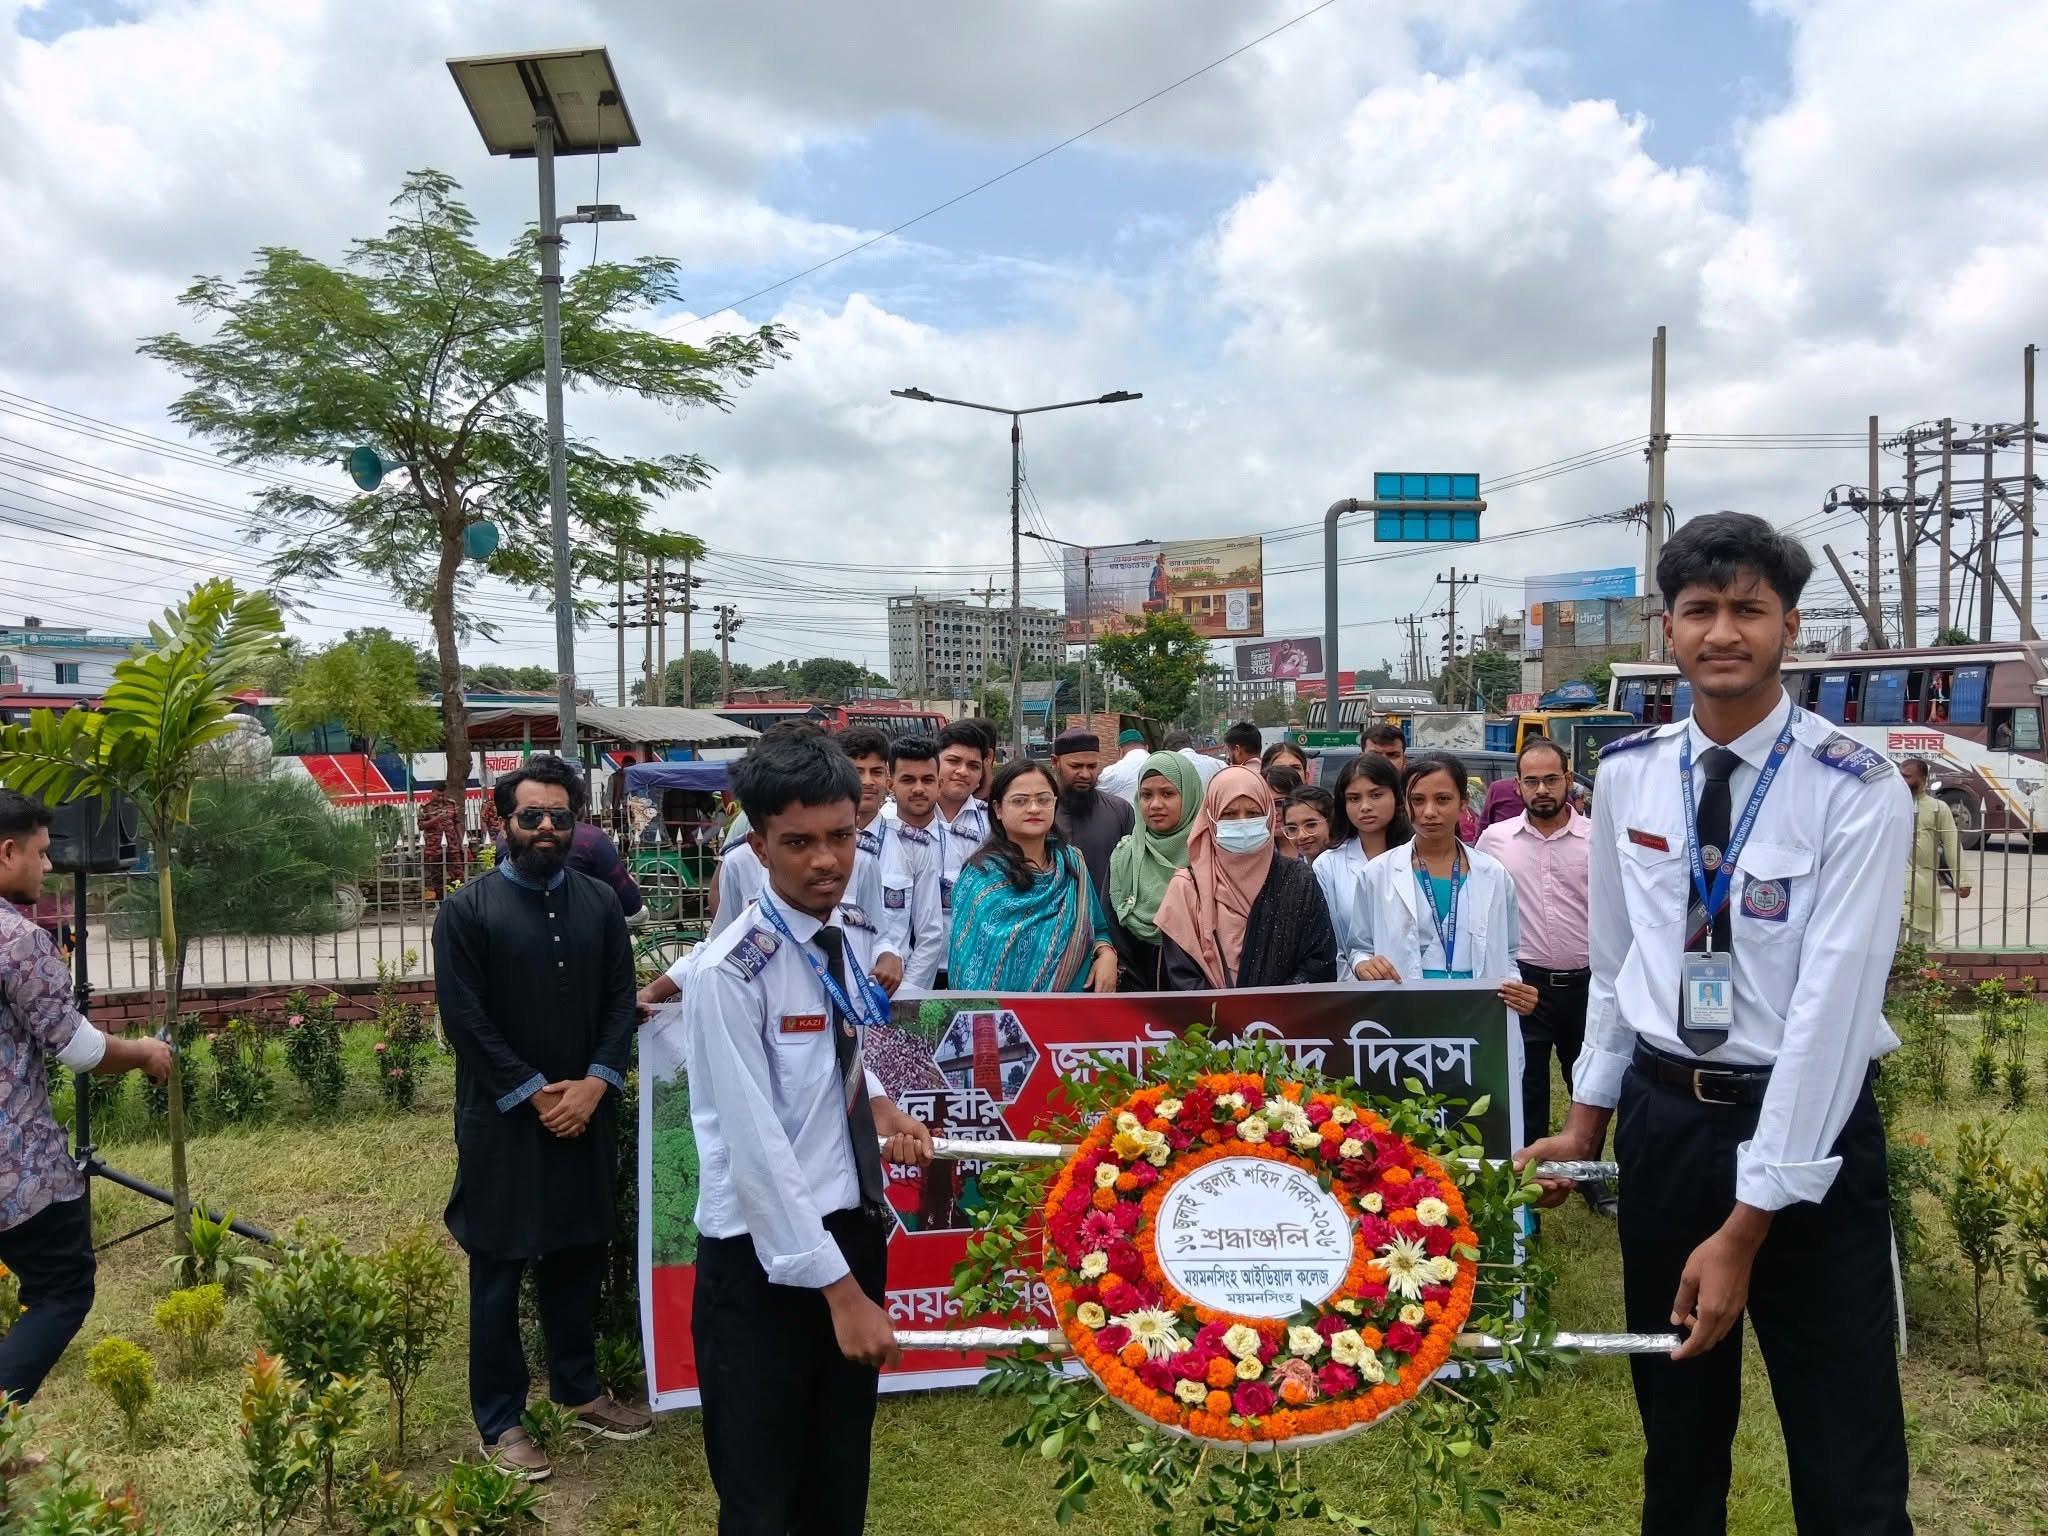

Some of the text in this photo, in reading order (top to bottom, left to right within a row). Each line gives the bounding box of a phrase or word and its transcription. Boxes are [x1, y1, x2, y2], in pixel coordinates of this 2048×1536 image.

[1682, 781, 1702, 878] MYMENSINGH IDEAL COLLEGE
[1725, 767, 1775, 864] MYMENSINGH IDEAL COLLEGE
[770, 914, 786, 932] IDEAL
[822, 974, 849, 1014] MYMENSINGH
[1044, 1023, 1178, 1084] জলা
[1342, 1019, 1481, 1087] দিবস
[945, 1088, 1000, 1125] বীর
[1244, 1163, 1283, 1189] শহিদ
[1172, 1194, 1206, 1230] জুলাই
[1174, 1234, 1197, 1254] ১৬
[1200, 1222, 1309, 1250] শ্রদ্ধাঞ্জলি
[1183, 1263, 1330, 1288] ময়মনসিংহ আইডিয়াল কলেজ
[885, 1268, 1053, 1324] ময়সিং
[1225, 1289, 1296, 1305] ময়মনসিংহ
